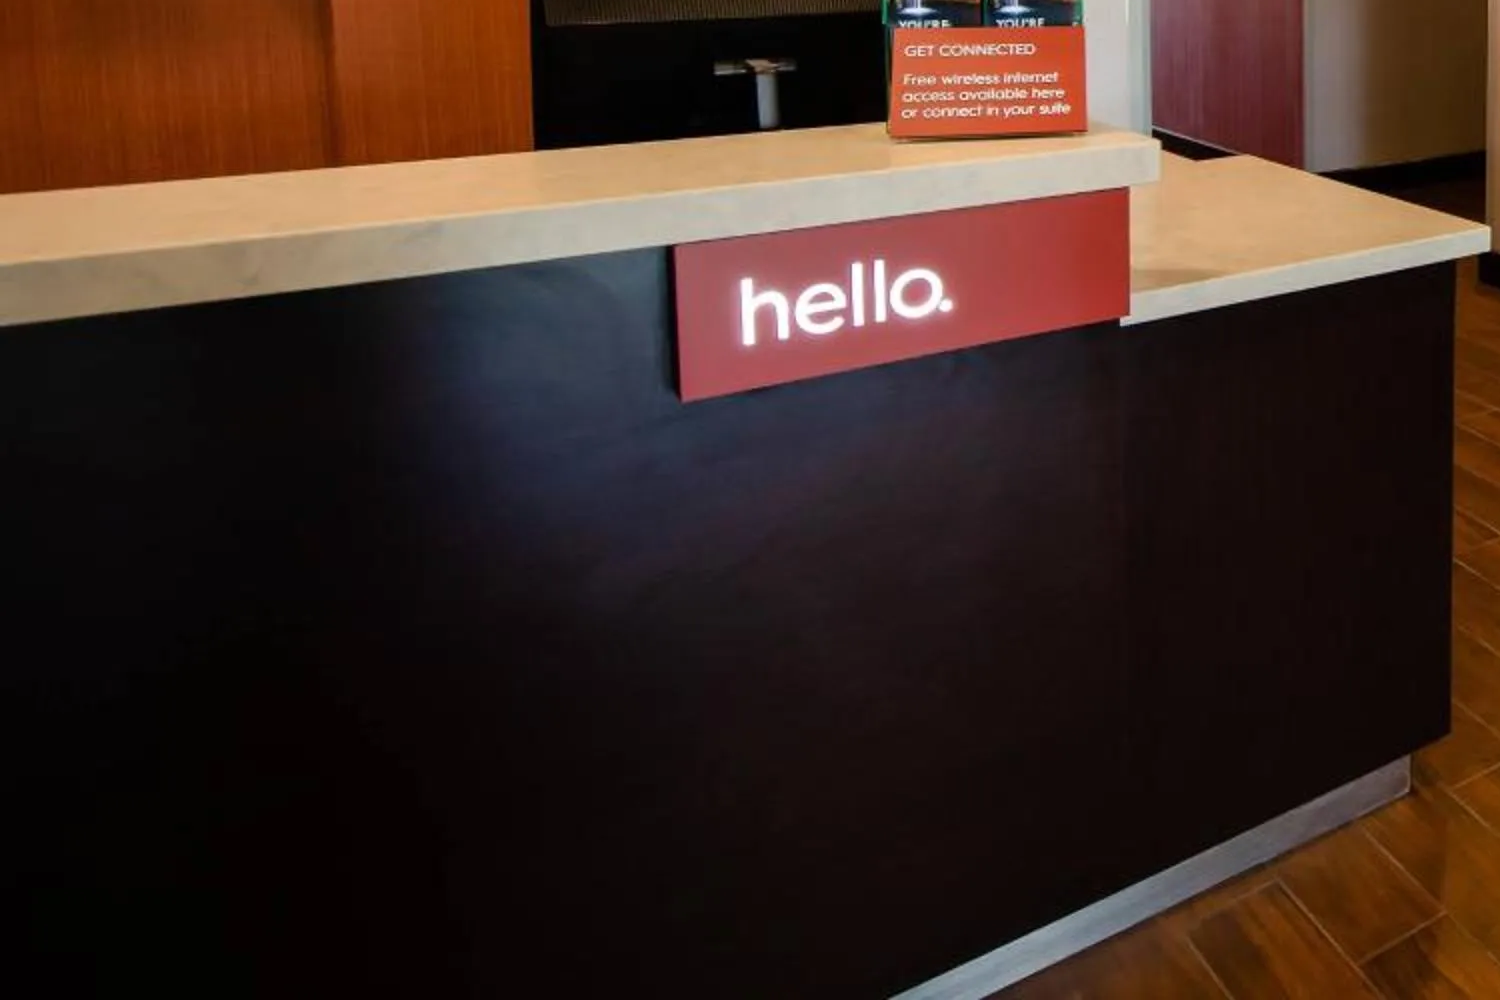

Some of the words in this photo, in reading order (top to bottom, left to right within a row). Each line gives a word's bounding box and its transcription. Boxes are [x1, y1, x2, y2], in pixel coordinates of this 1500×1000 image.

[904, 45, 934, 58] GET
[939, 43, 1036, 57] CONNECTED
[903, 73, 936, 86] Free
[941, 73, 1000, 85] wireless
[1003, 72, 1059, 84] internet
[902, 92, 955, 103] access
[959, 87, 1028, 101] available
[1032, 87, 1066, 99] here
[901, 109, 918, 119] or
[923, 105, 982, 118] connect
[986, 105, 999, 117] in
[1003, 105, 1036, 119] your
[1039, 103, 1072, 115] suite
[740, 258, 953, 346] hello.
